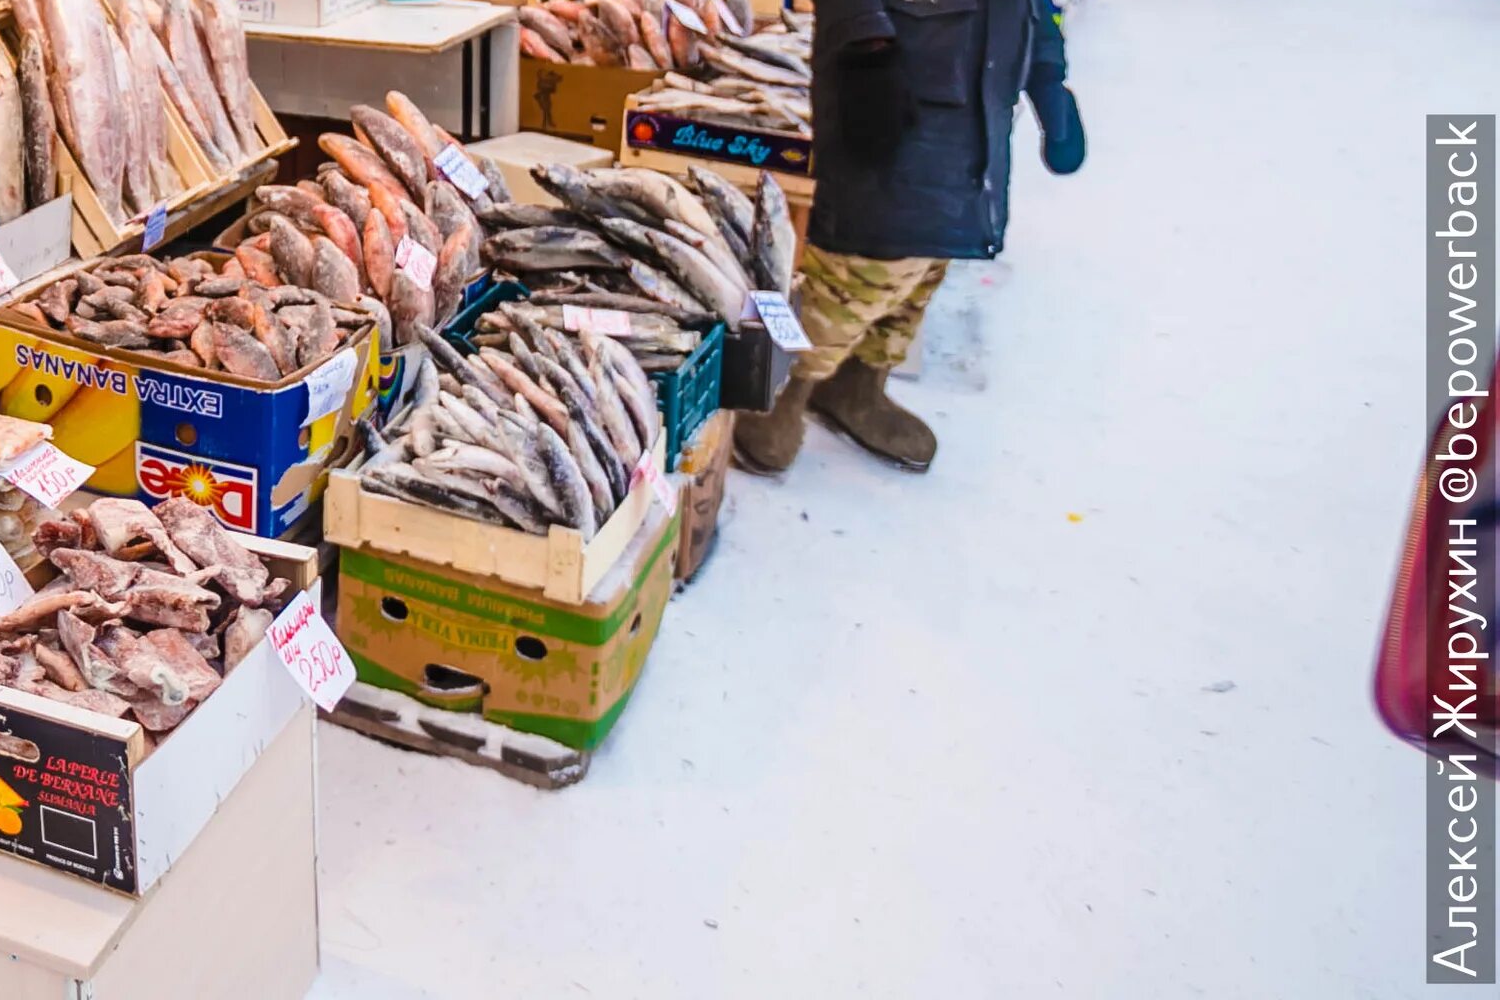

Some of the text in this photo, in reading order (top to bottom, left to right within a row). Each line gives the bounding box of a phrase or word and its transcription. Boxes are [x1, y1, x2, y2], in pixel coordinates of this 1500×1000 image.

[673, 124, 771, 164] Blue Sky
[16, 344, 223, 419] EXTRA BANANAS
[13, 764, 38, 783] DE
